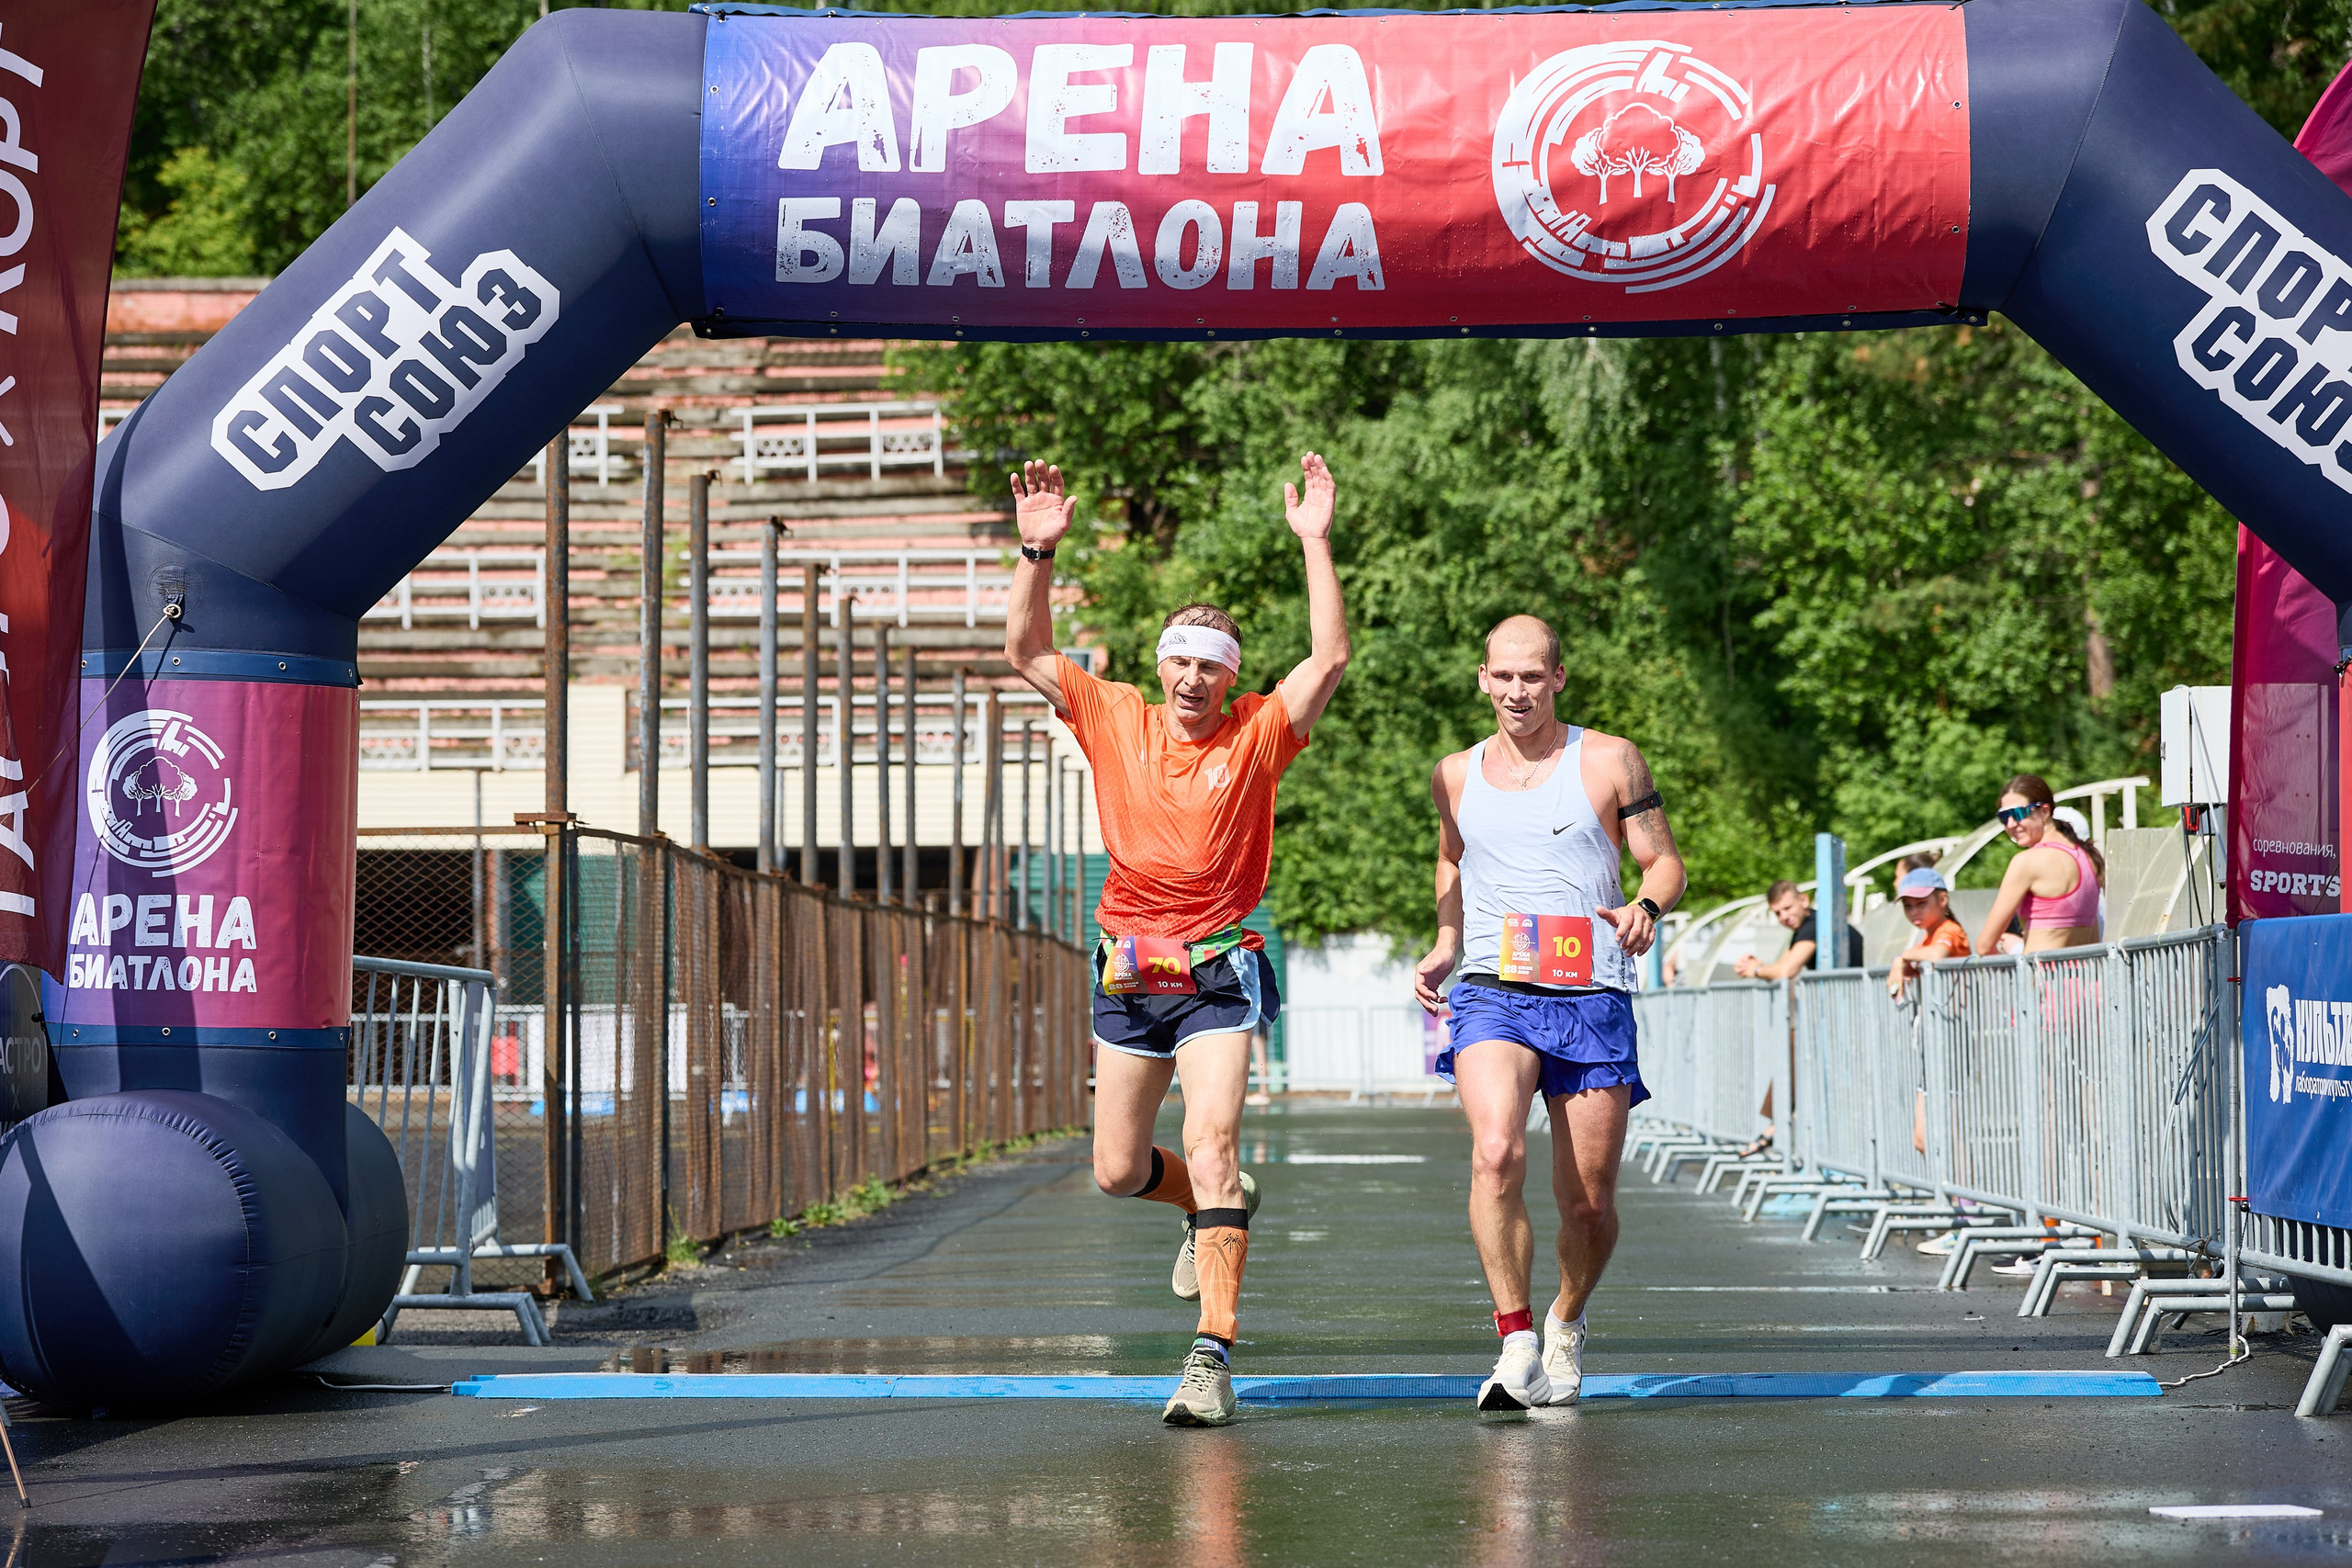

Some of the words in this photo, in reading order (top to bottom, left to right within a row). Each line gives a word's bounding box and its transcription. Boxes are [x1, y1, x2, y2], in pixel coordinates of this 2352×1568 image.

[777, 42, 1385, 176] АРЕНА
[775, 197, 1385, 290] БИАТЛОНА
[2165, 184, 2352, 347] СПОР
[227, 249, 442, 474] СПОРТ
[354, 268, 541, 457] СОЮЗ
[2253, 839, 2336, 859] соревнования,
[70, 892, 257, 950] АРЕНА
[1553, 936, 1581, 958] 10
[68, 953, 257, 993] БИАТЛОНА
[1148, 956, 1182, 976] 70
[1552, 969, 1564, 977] 10
